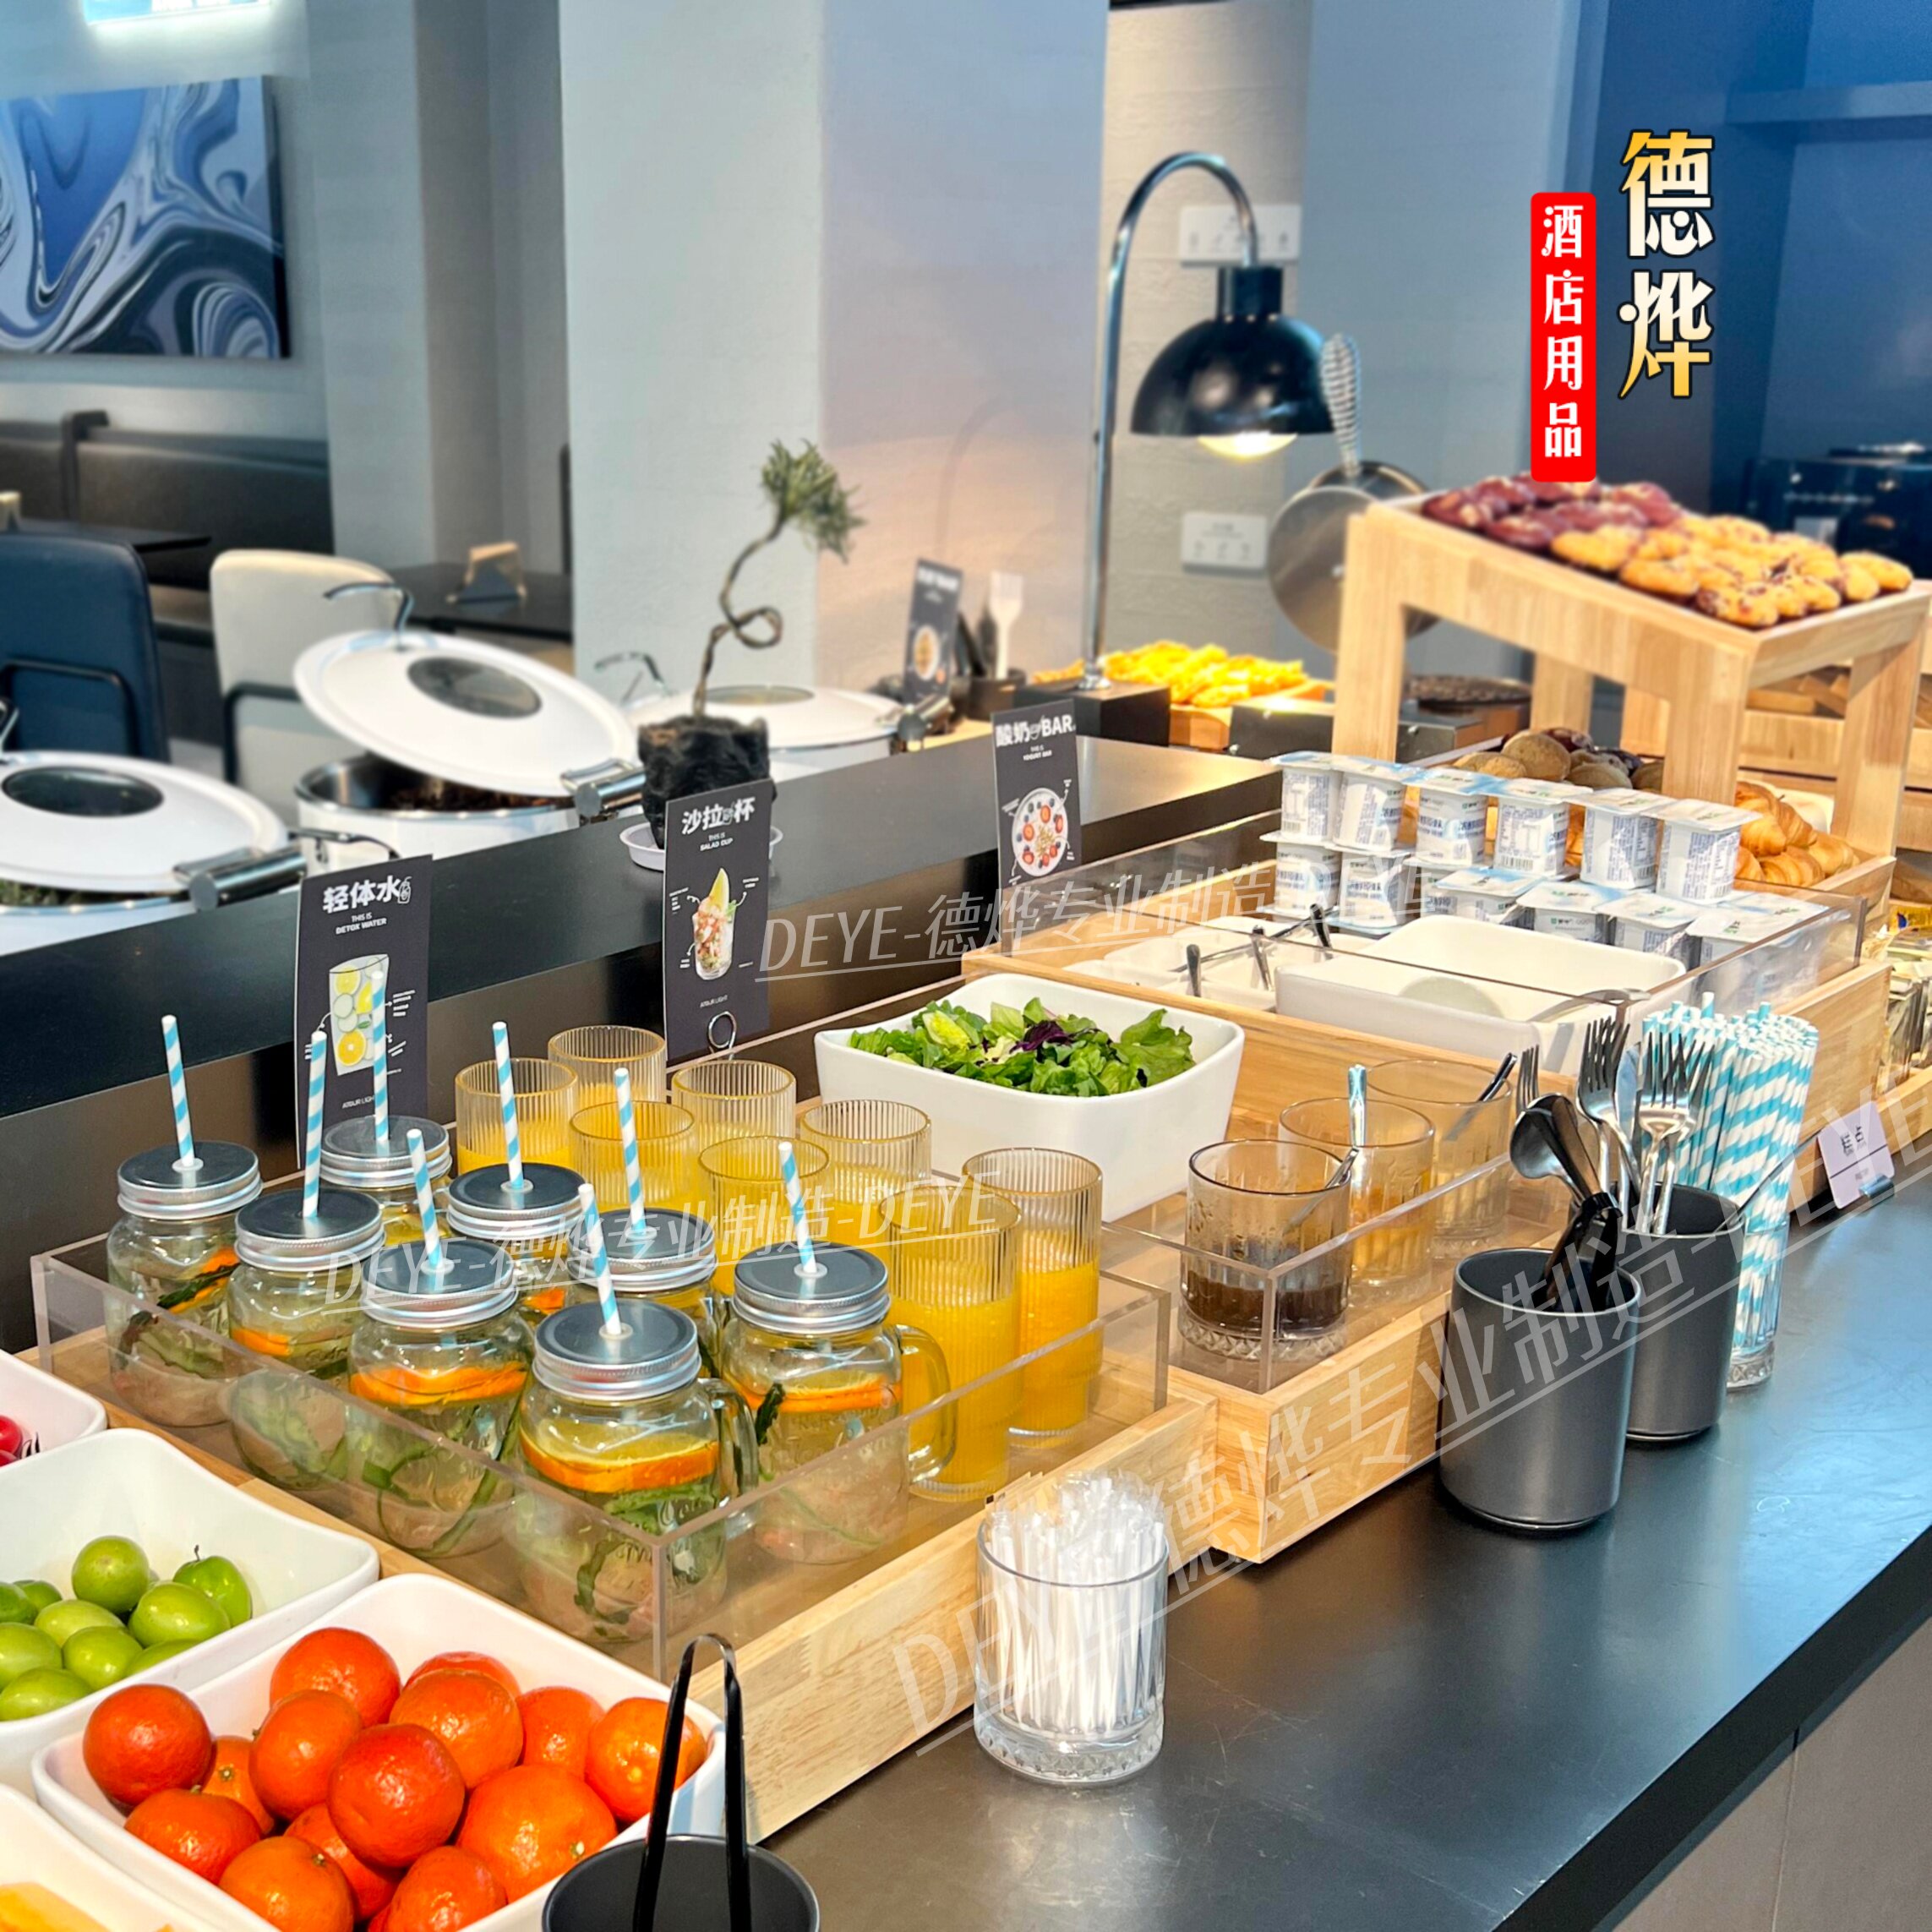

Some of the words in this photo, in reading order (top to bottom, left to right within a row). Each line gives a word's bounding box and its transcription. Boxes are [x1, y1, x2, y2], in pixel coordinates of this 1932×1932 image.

[322, 875, 401, 914] 轻体水
[336, 924, 361, 935] DETOX
[361, 918, 387, 929] WATER
[351, 914, 366, 923] THIS
